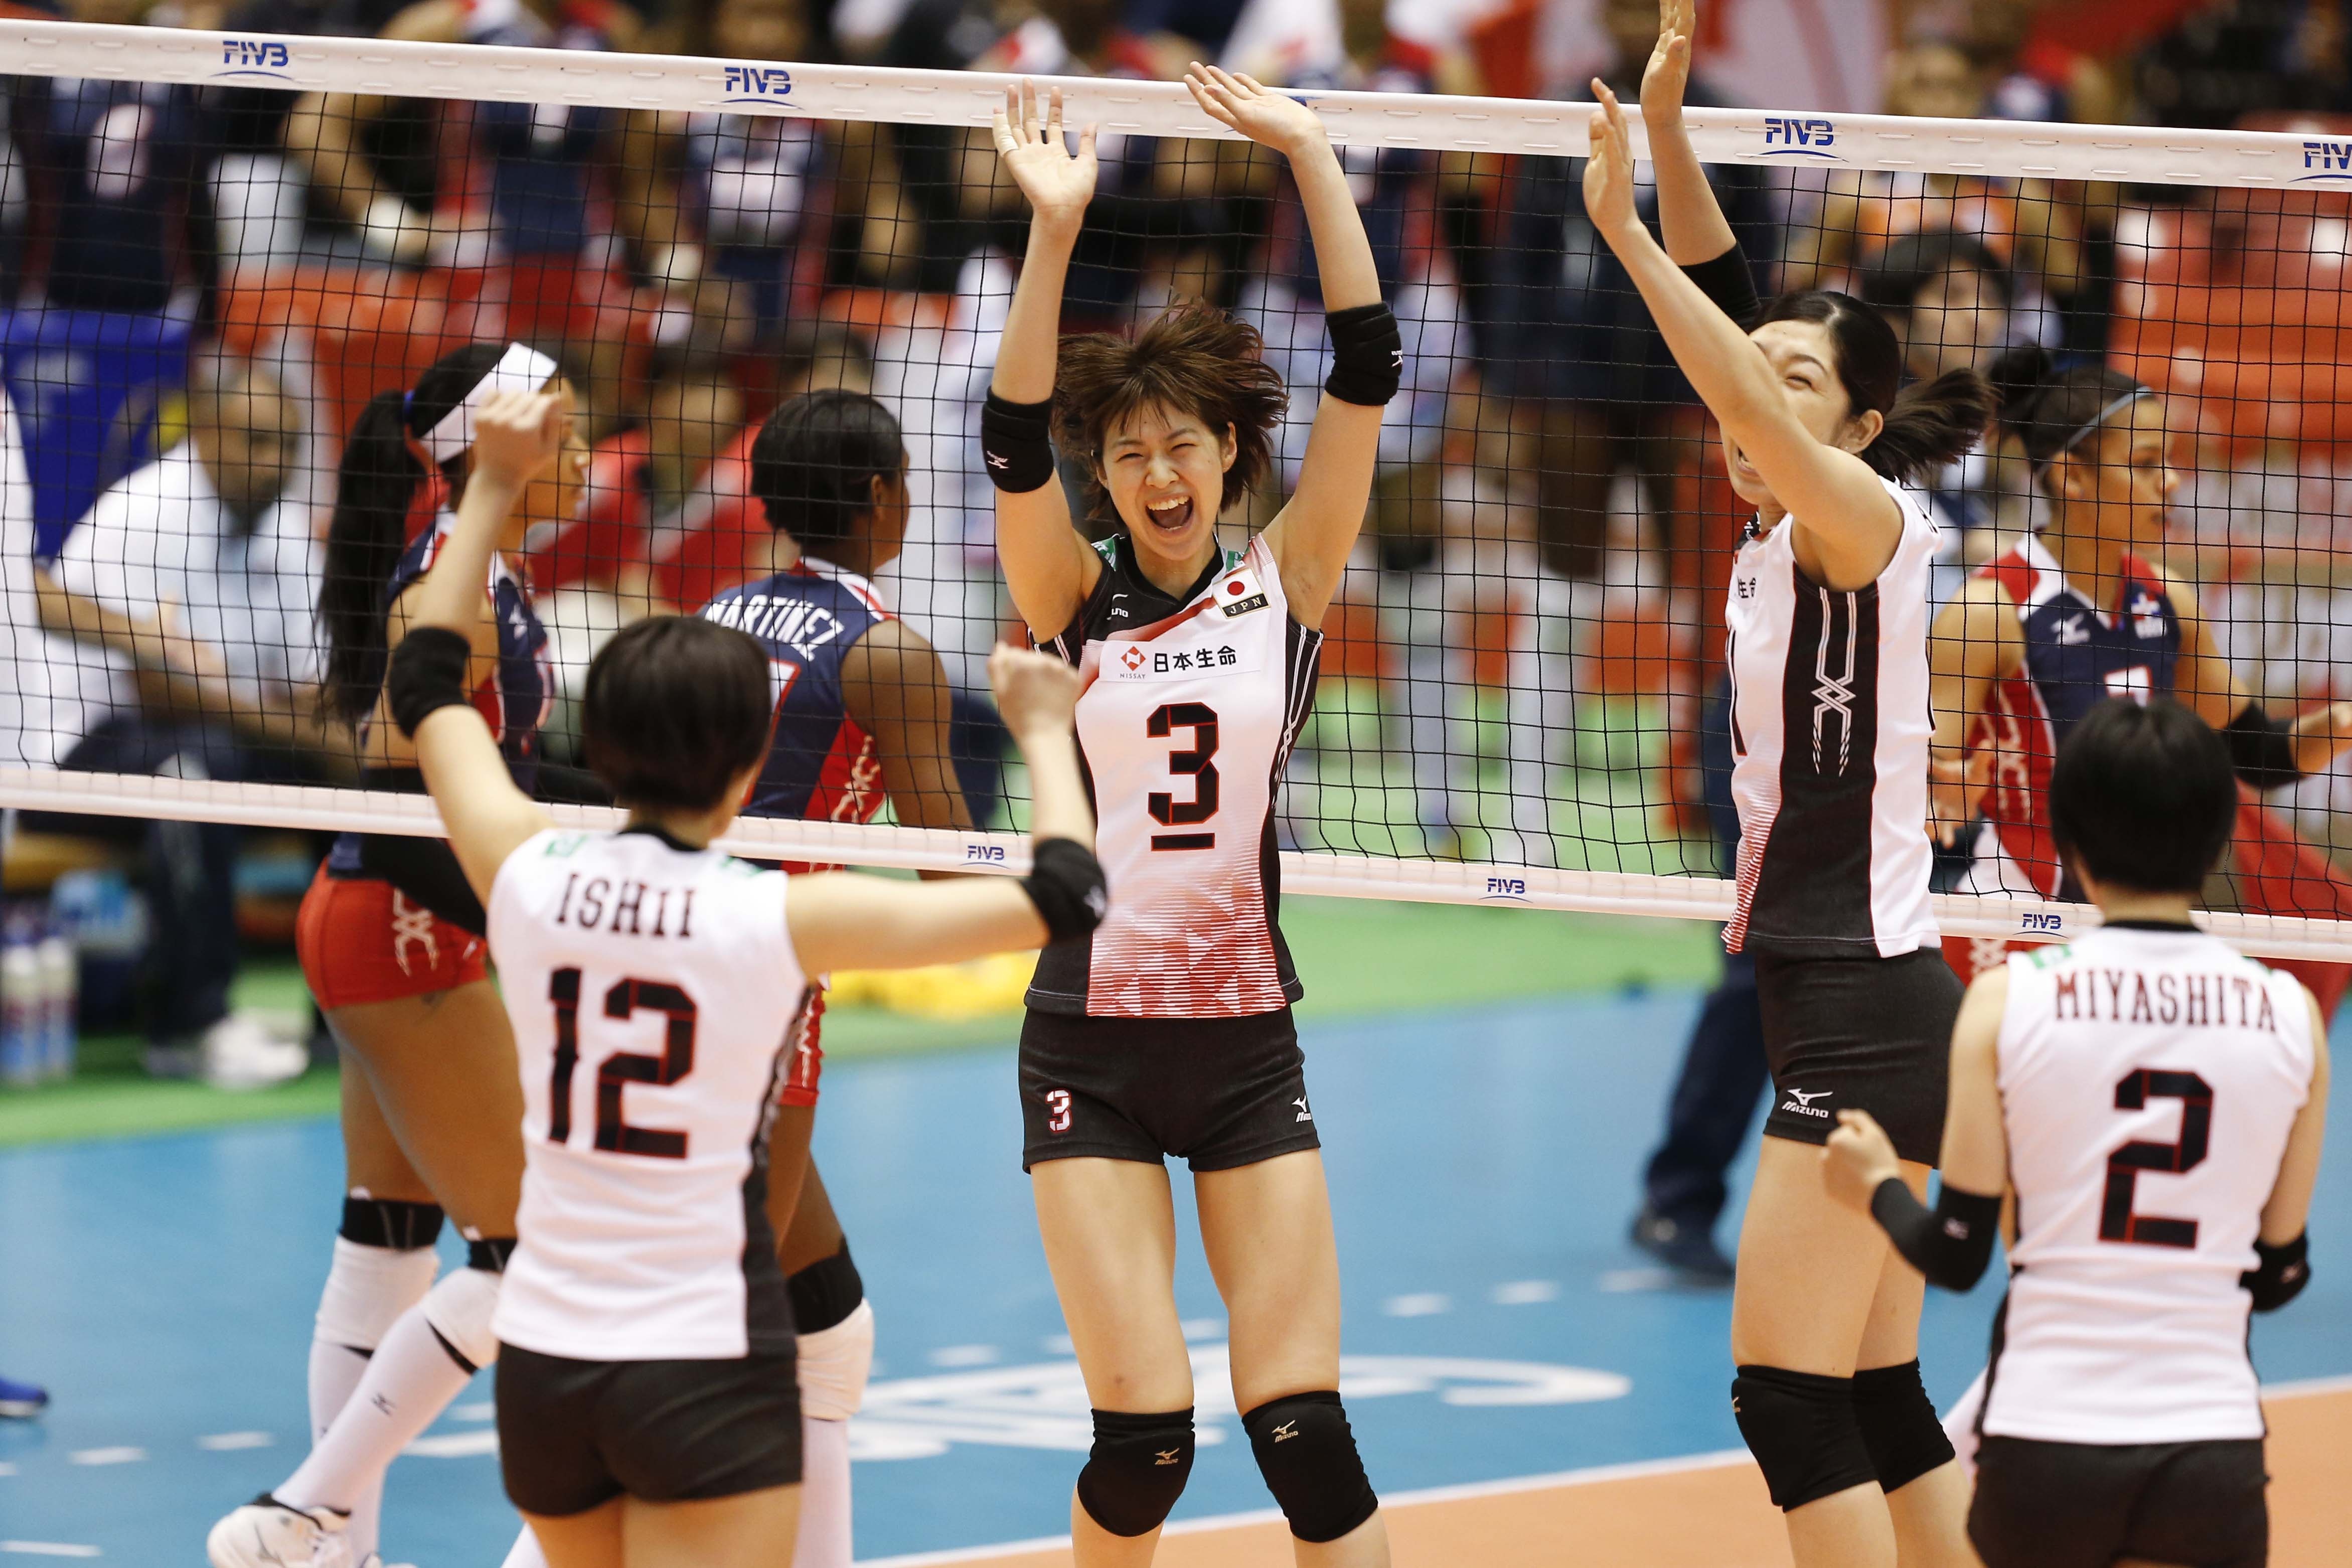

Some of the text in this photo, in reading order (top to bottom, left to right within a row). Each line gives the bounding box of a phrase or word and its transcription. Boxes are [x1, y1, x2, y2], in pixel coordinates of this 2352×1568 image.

[223, 40, 288, 67] FIVB
[725, 67, 791, 94] FIVB
[1765, 118, 1833, 145] FIVB
[2303, 142, 2352, 169] FIV
[1230, 597, 1262, 614] JPN
[1154, 645, 1237, 673] 日本生命
[1147, 702, 1219, 826] 3
[968, 845, 1004, 860] FIVB
[1487, 878, 1525, 894] FIVB
[556, 872, 696, 937] ISHII
[2022, 913, 2062, 929] FIVB
[2056, 970, 2276, 1033] MIYASHITA
[549, 968, 697, 1160] 12
[1045, 1088, 1072, 1134] 3
[2098, 1068, 2214, 1249] 2
